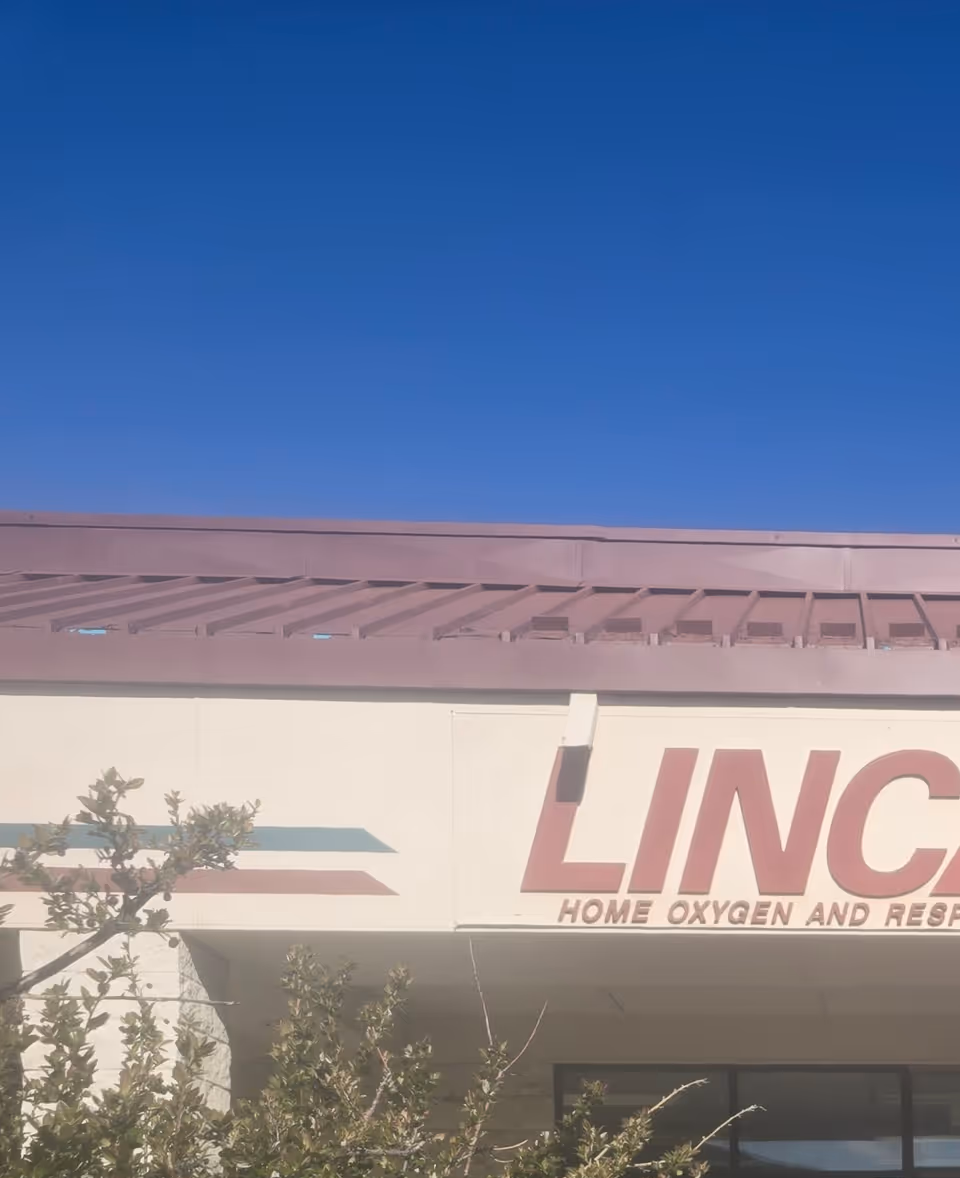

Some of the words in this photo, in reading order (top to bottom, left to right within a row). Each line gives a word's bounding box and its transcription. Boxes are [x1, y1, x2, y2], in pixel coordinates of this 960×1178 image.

[557, 899, 653, 925] HOME
[667, 900, 794, 926] OXYGEN
[805, 901, 870, 927] AND
